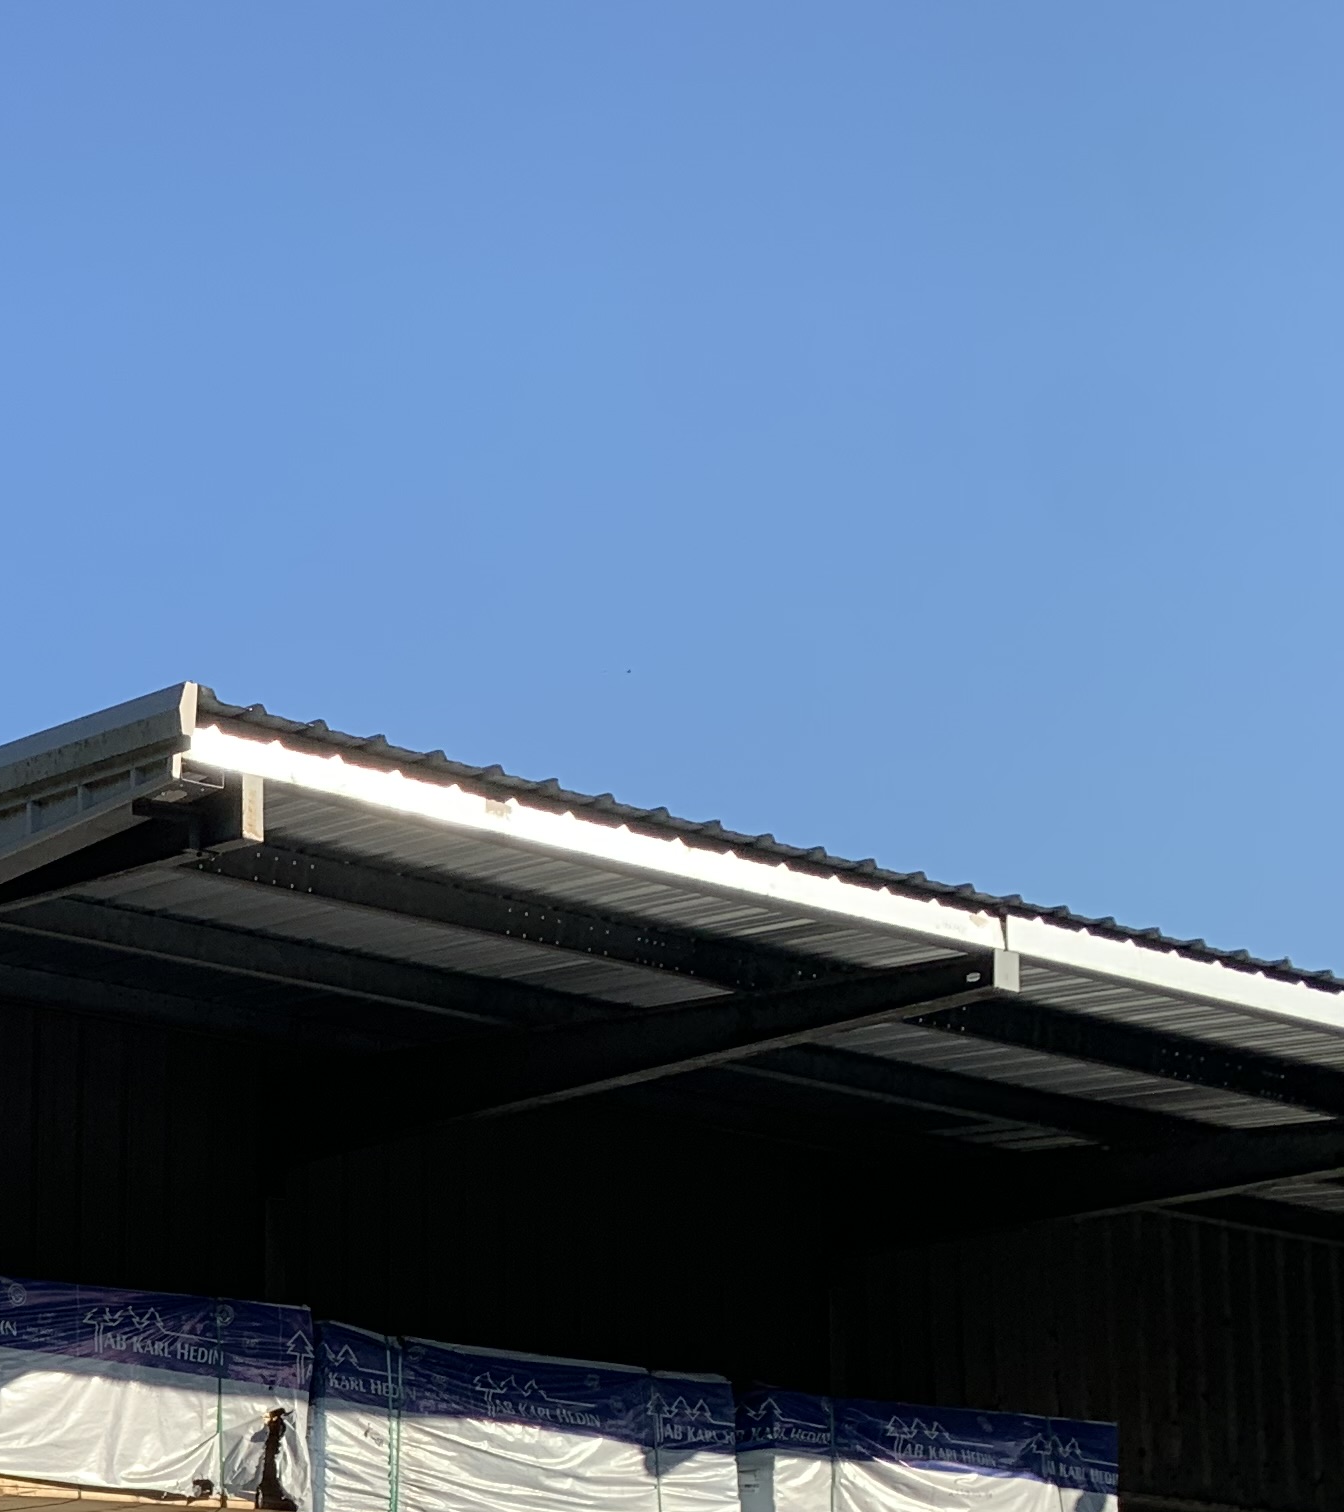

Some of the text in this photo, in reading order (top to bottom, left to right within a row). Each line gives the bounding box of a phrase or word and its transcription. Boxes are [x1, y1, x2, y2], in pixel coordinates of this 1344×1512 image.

[103, 1333, 225, 1367] AB KARL HEDIN
[328, 1371, 367, 1394] KARL
[664, 1425, 683, 1442] AB
[904, 1443, 924, 1459] AB
